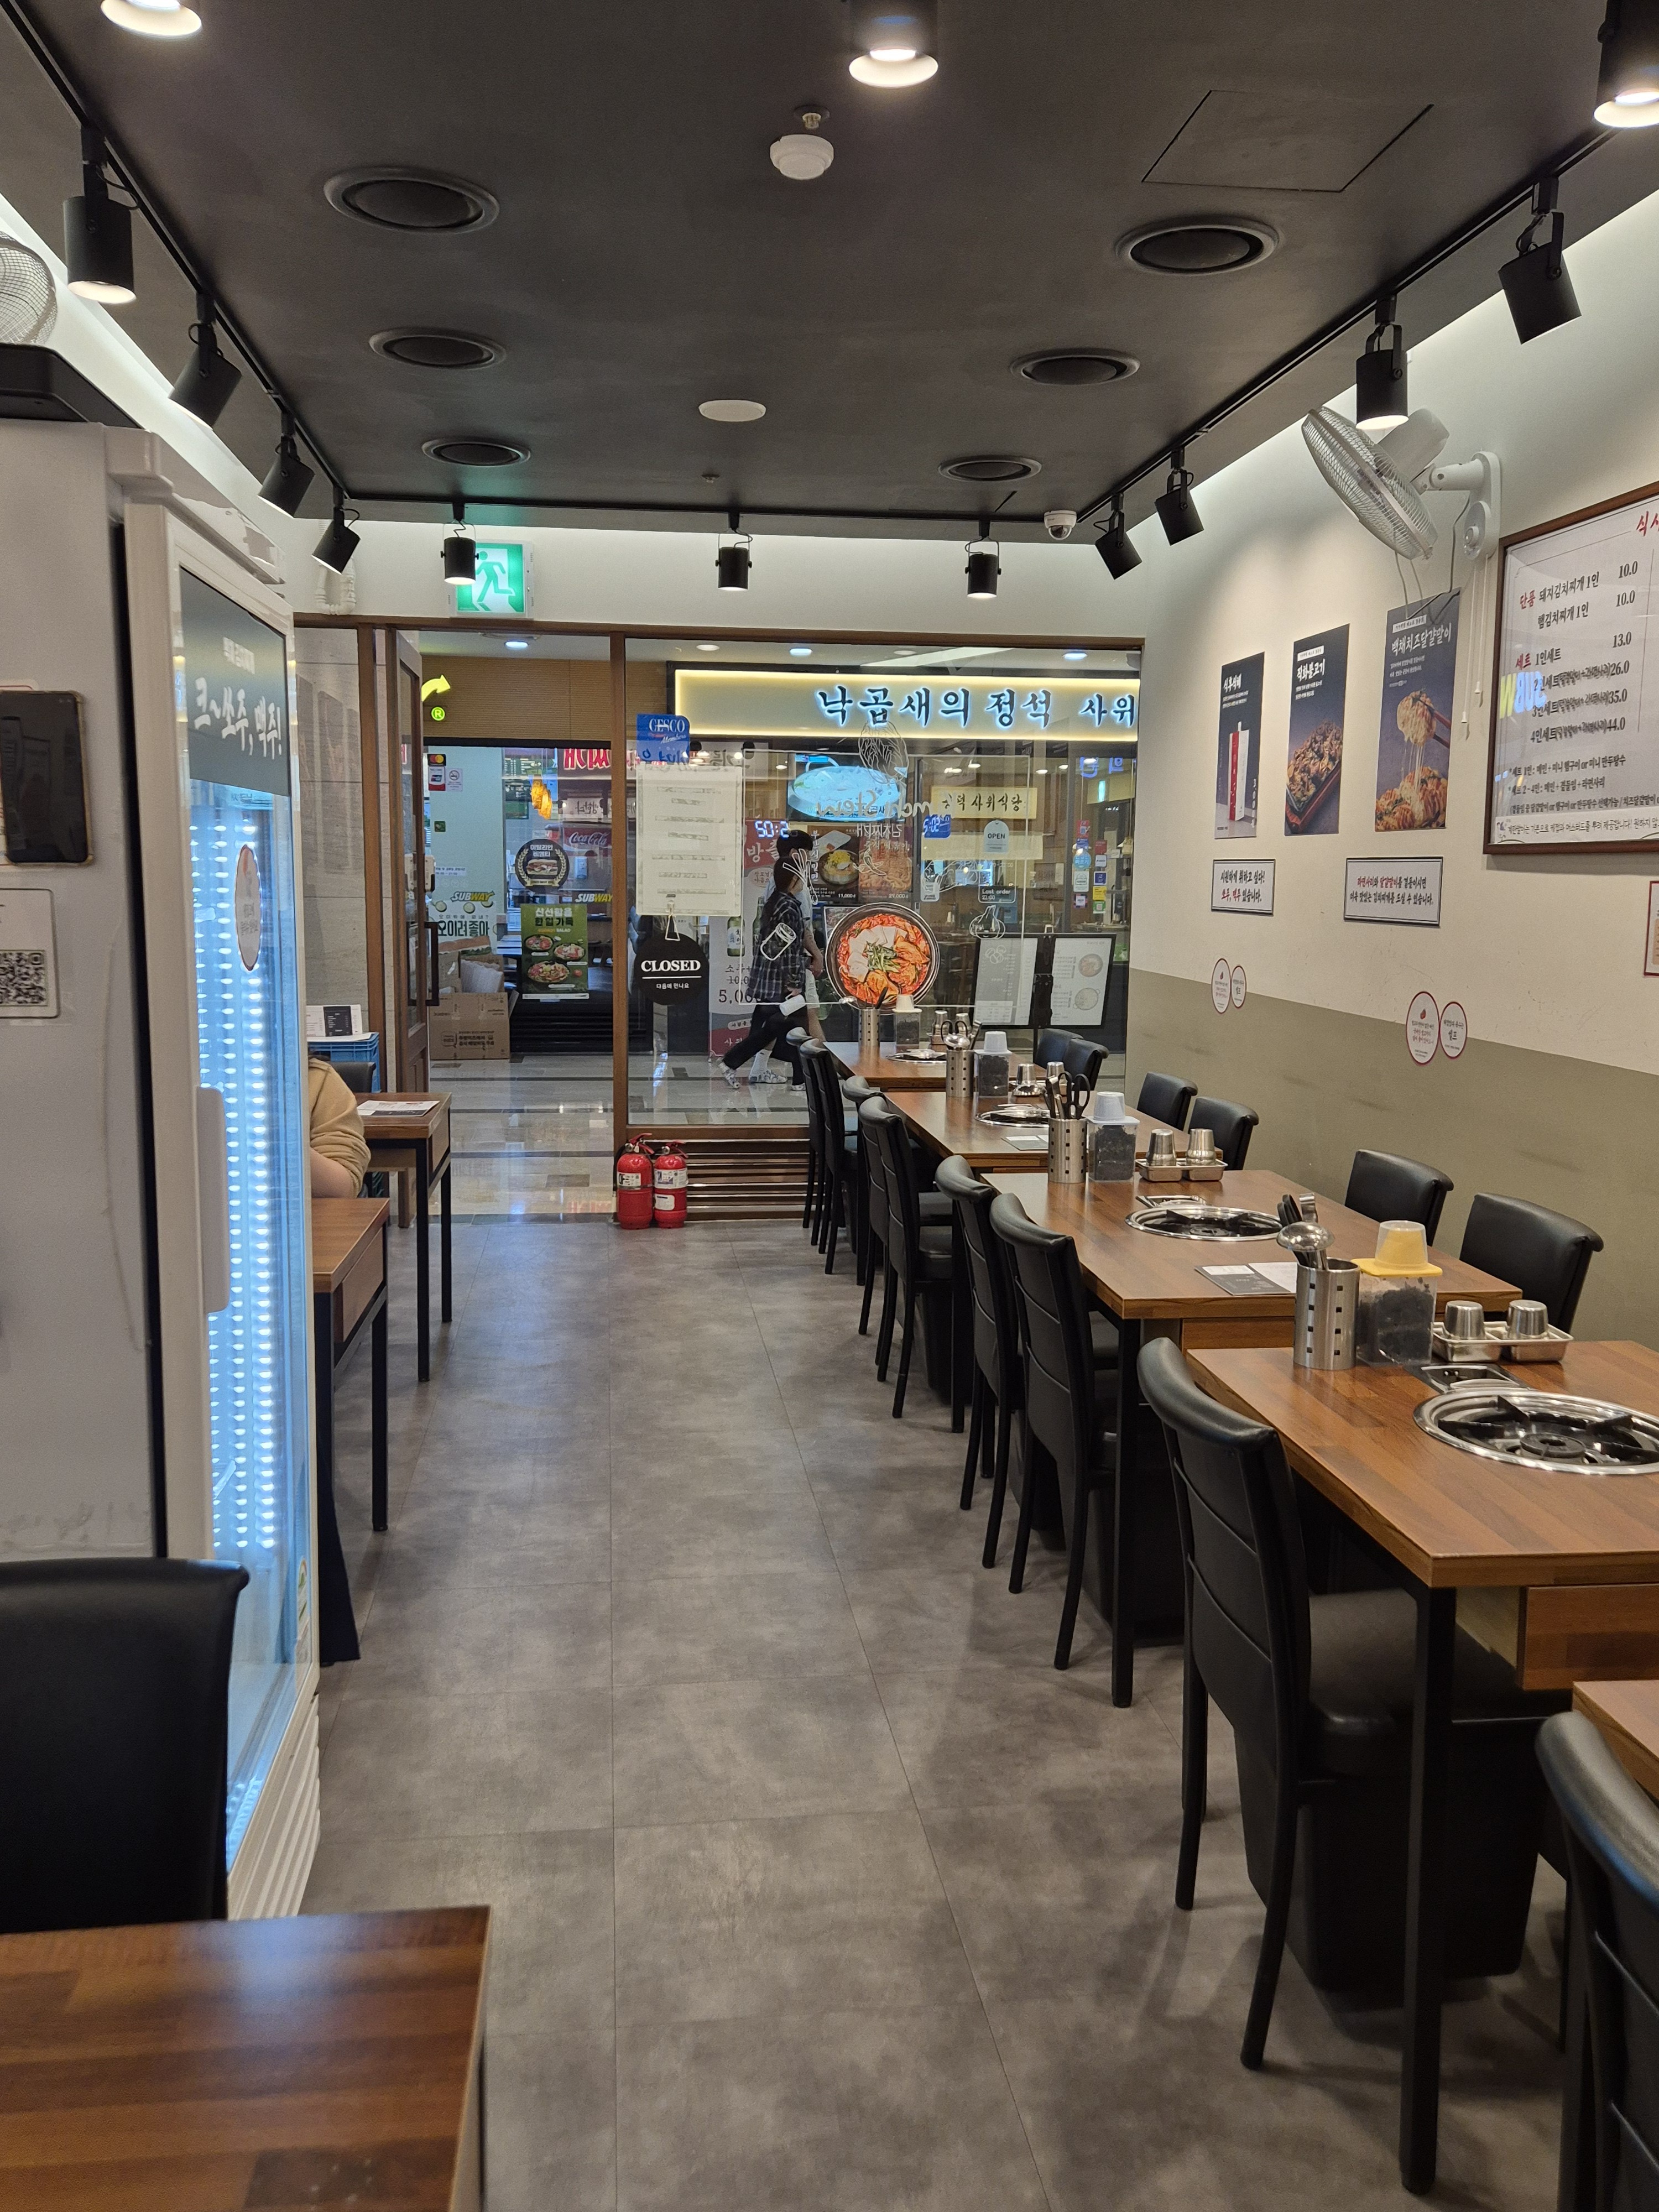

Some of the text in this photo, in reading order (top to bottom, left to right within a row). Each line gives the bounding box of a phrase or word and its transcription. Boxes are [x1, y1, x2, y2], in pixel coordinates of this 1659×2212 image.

[1618, 561, 1638, 578] 10.0
[1520, 589, 1536, 609] 단품
[1616, 590, 1635, 607] 10.0
[1612, 632, 1632, 648] 13.0
[1515, 648, 1561, 670] 세트 1인세트
[1610, 660, 1630, 676] 26.0
[1608, 688, 1627, 704] 35.0
[818, 685, 1135, 729] 낙곱새의 정석 사위
[649, 718, 685, 733] CESCO
[1606, 717, 1626, 731] 44.0
[971, 792, 1022, 813] 사위식당
[1220, 869, 1265, 884] 시원하게 취하고 싶다!
[451, 891, 495, 902] SUBWAY
[575, 893, 613, 903] SUBWAY
[1406, 893, 1412, 905] 수
[641, 959, 701, 972] CLOSED
